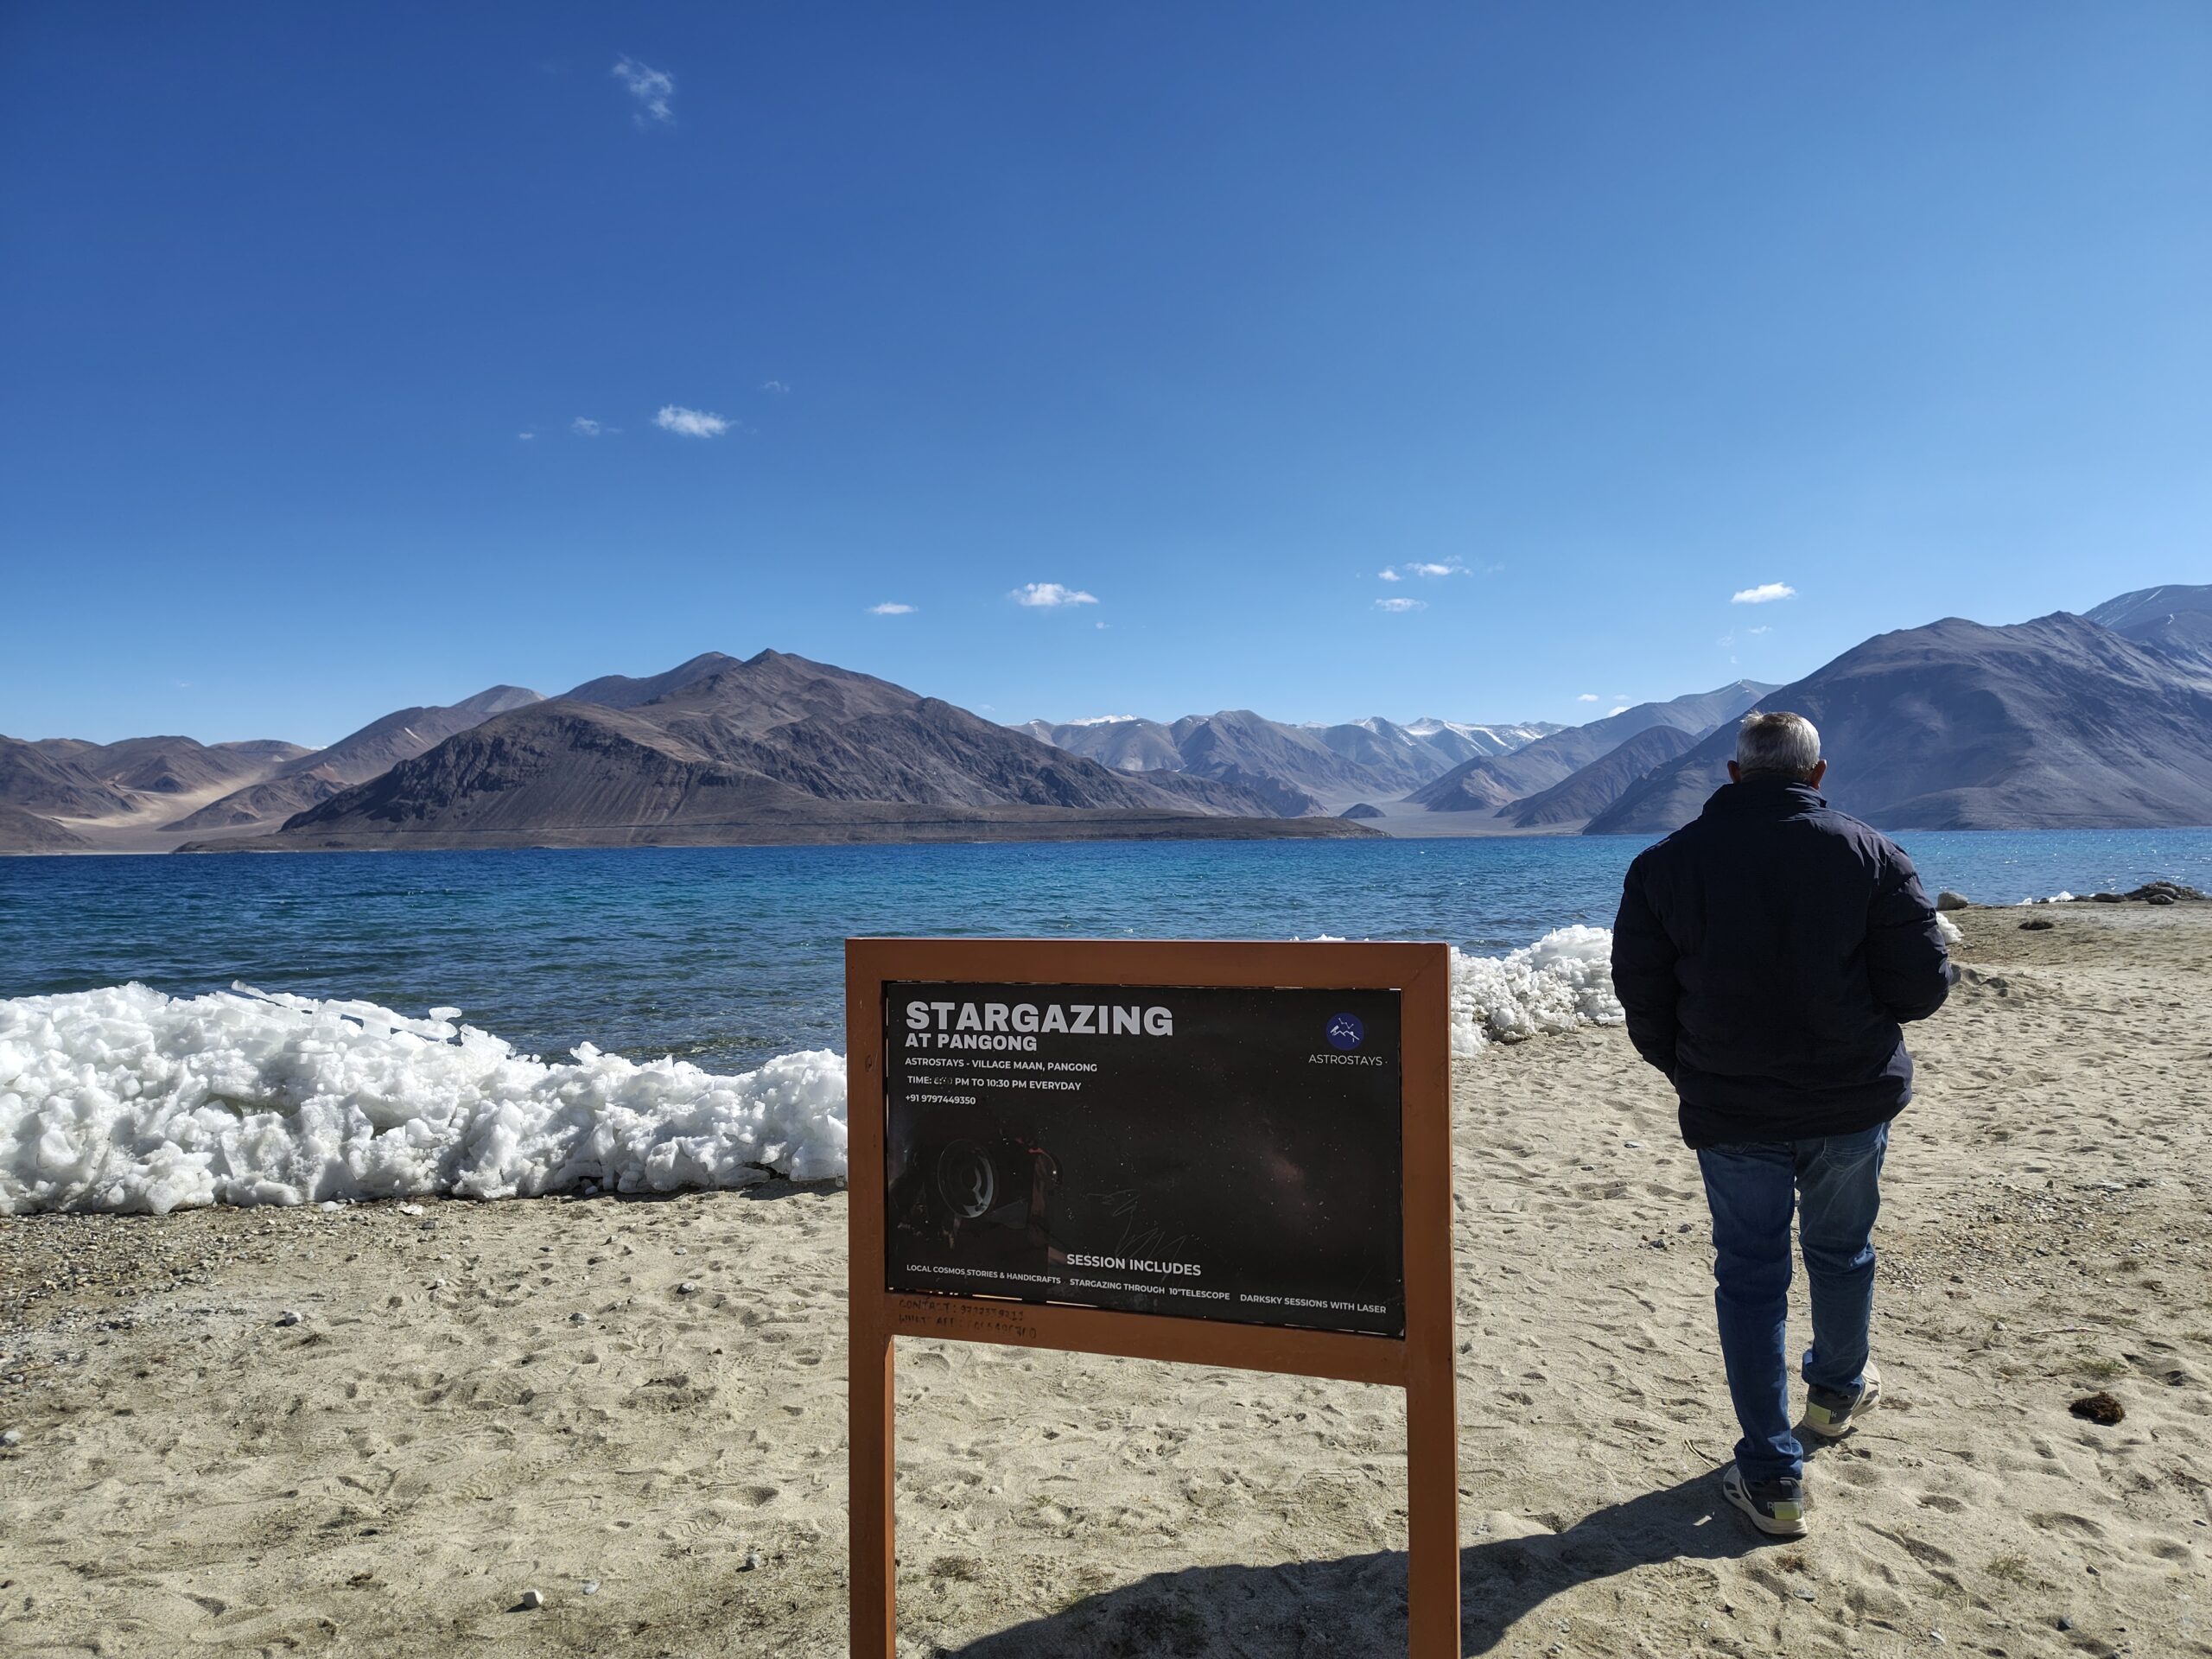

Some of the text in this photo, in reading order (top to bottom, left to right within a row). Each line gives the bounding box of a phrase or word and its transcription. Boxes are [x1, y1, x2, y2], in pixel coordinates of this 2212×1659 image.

[906, 1001, 1173, 1036] STARGAZING
[905, 1033, 1038, 1051] AT PANGONG
[905, 1057, 965, 1067] ASTROSTAYS
[971, 1059, 1012, 1070] VILLAGE
[1013, 1061, 1046, 1072] MAAN,
[1047, 1062, 1097, 1072] PANGONG
[1308, 1054, 1382, 1066] ASTROSTAYS
[906, 1075, 932, 1084] TIME:
[955, 1077, 969, 1086] PM
[970, 1077, 985, 1087] TO
[986, 1078, 1010, 1088] 10:30
[1012, 1079, 1027, 1089] PM
[1029, 1080, 1082, 1090] EVERYDAY
[905, 1094, 976, 1105] +91 9797449350
[1066, 1253, 1202, 1276] SESSION INCLUDES
[906, 1264, 932, 1273] LOCAL
[932, 1266, 966, 1275] COSMOS
[966, 1268, 998, 1279] STORIES
[1007, 1272, 1061, 1284] HANDICRAFTS
[1070, 1278, 1122, 1290] STARGAZING
[1122, 1283, 1166, 1294] THROUGH
[1240, 1294, 1387, 1314] DARKSKY SESSIONS WITH LASER
